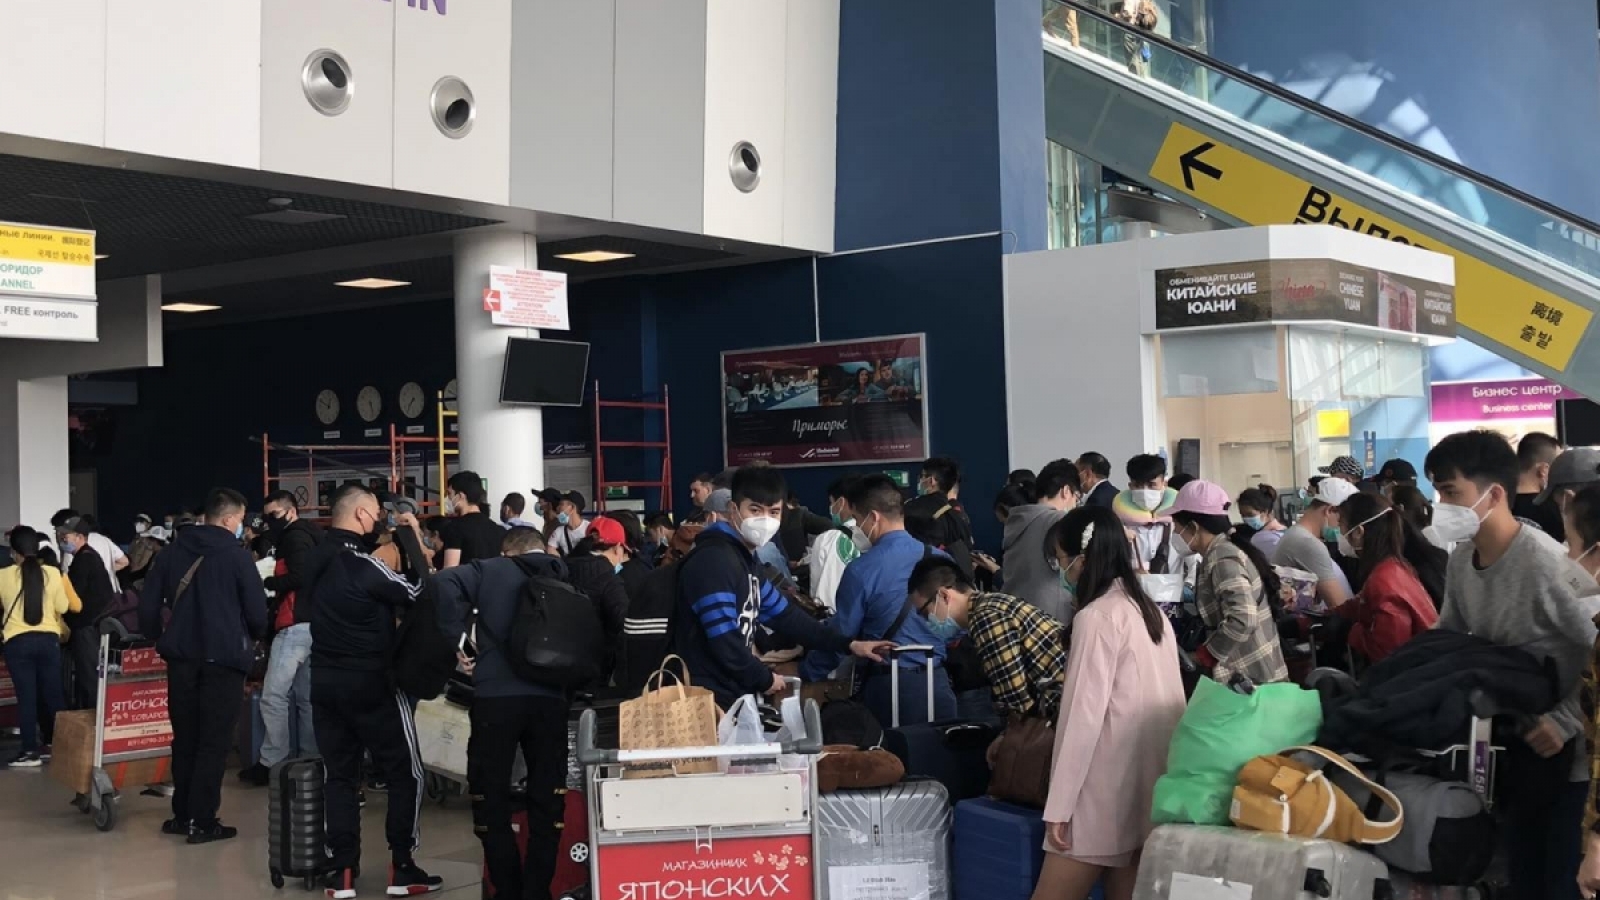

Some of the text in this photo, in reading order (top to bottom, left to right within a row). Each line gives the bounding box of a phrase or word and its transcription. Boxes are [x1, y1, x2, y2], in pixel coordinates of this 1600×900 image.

[0, 263, 44, 275] ОРИДОР
[1, 278, 35, 290] ANNEL
[1166, 280, 1258, 301] КИТАЙСКИЕ
[4, 305, 79, 319] FREE контроль
[1187, 298, 1237, 315] ЮАНИ
[1472, 384, 1562, 398] Бизнес центр
[1482, 402, 1553, 414] Business center
[662, 857, 748, 872] МАГАЗИНЧИК
[618, 873, 790, 900] ЯПОНСКИХ
